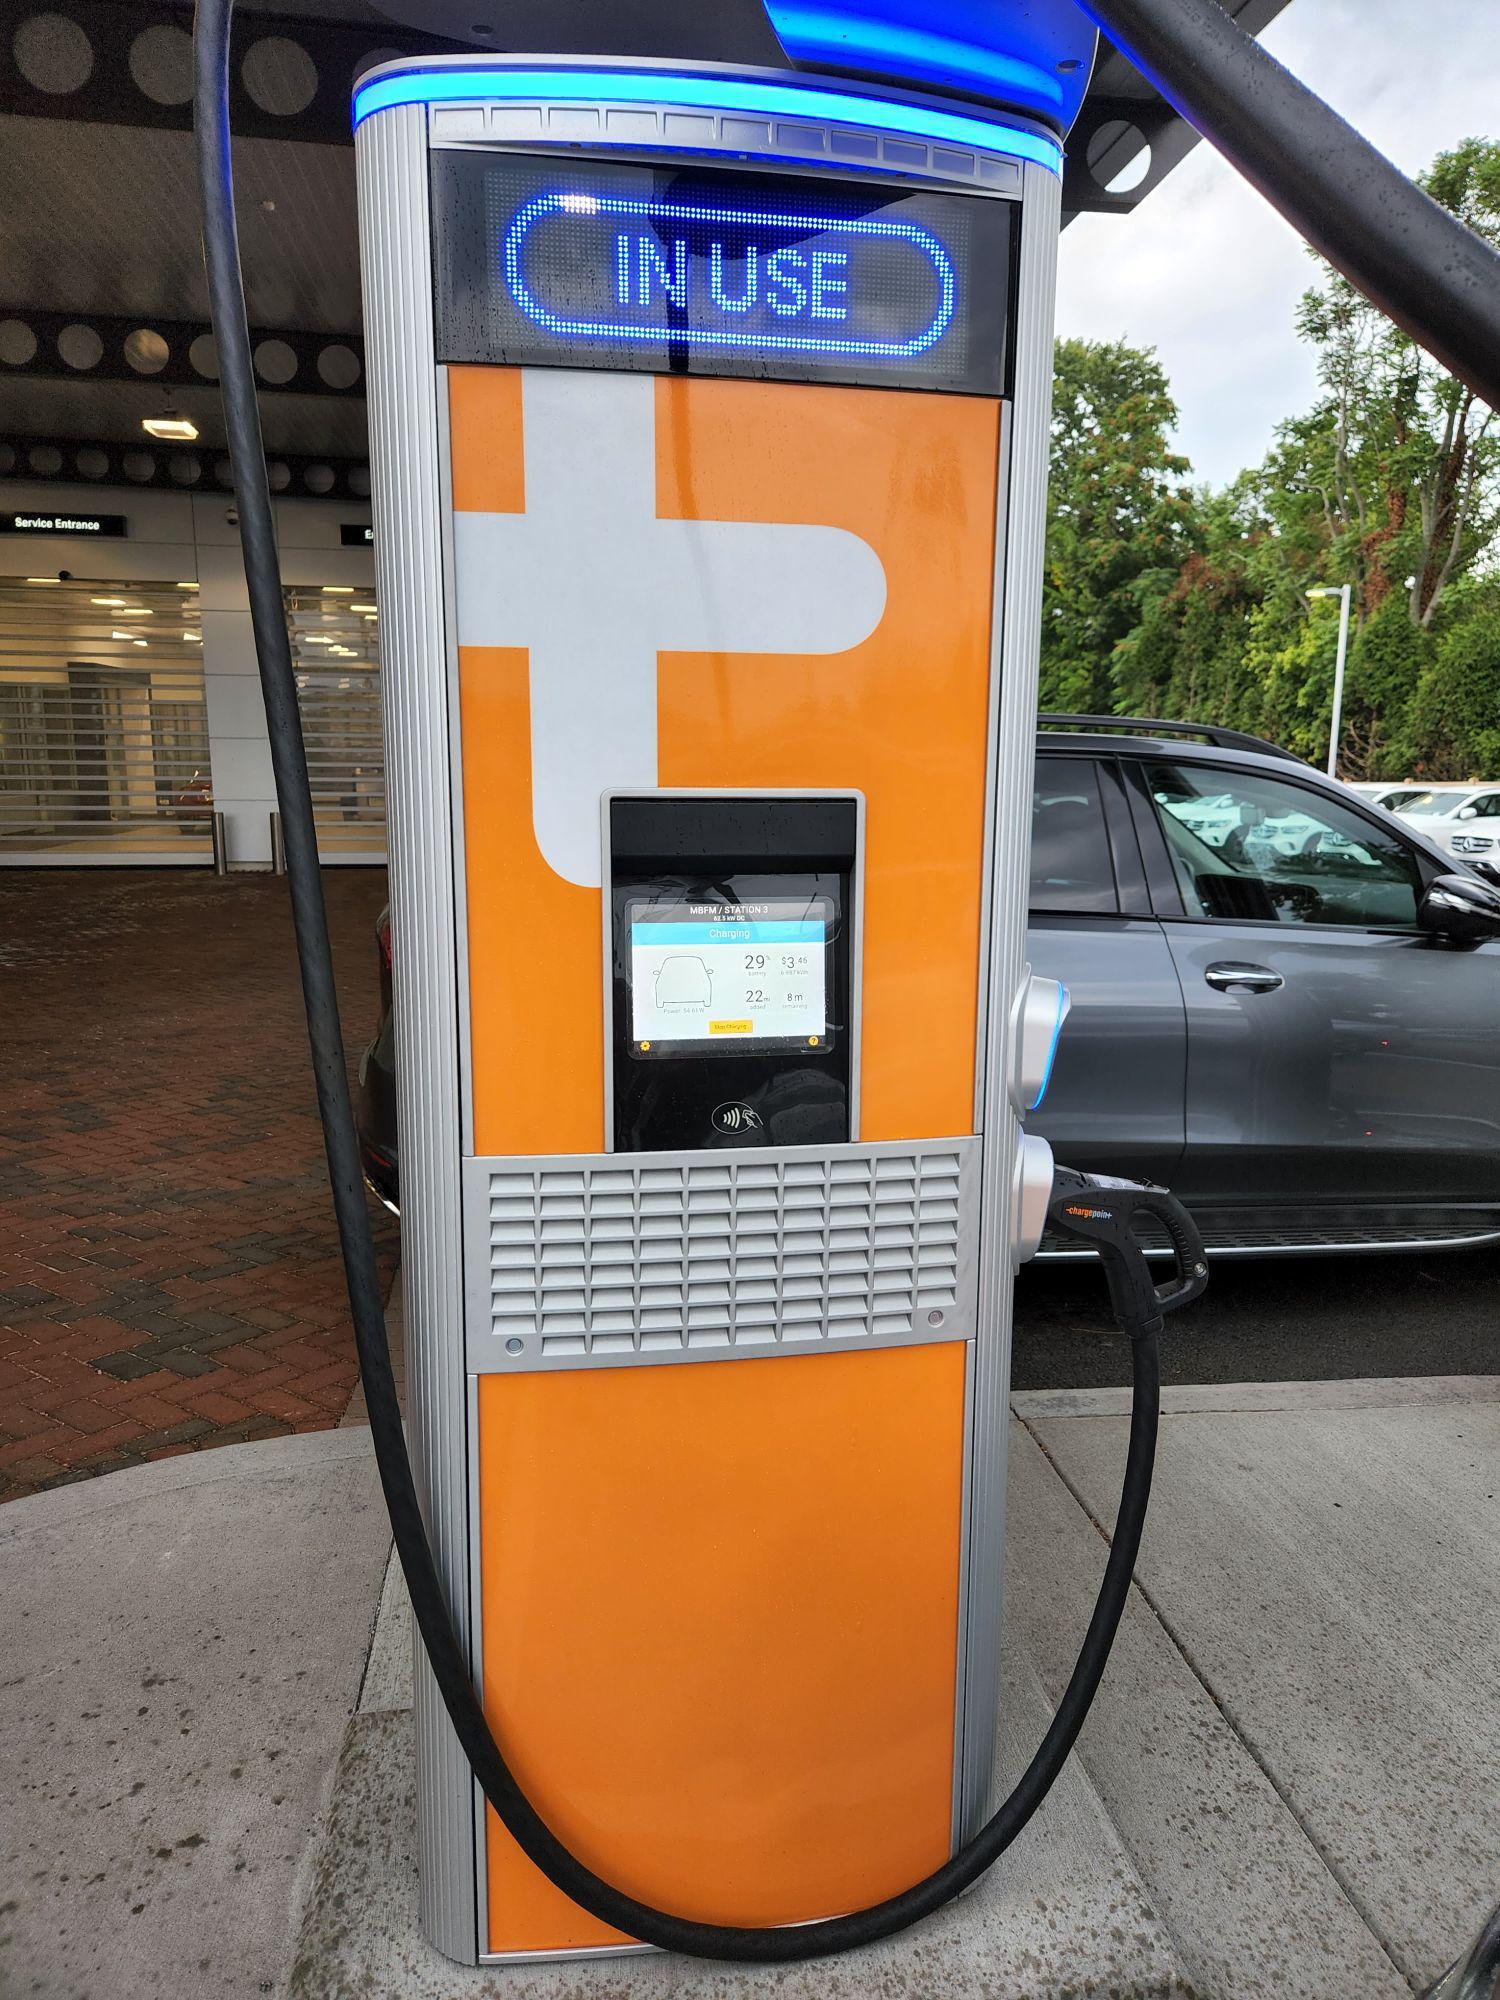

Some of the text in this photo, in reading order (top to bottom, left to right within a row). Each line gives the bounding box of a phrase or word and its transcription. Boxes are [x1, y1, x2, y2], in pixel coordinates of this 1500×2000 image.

[618, 234, 847, 319] IN USE
[14, 516, 100, 531] Service Entrance
[689, 906, 717, 915] MBFM
[724, 905, 761, 914] STATION
[762, 905, 769, 914] 3
[709, 928, 750, 940] Charging
[786, 992, 793, 1002] 8
